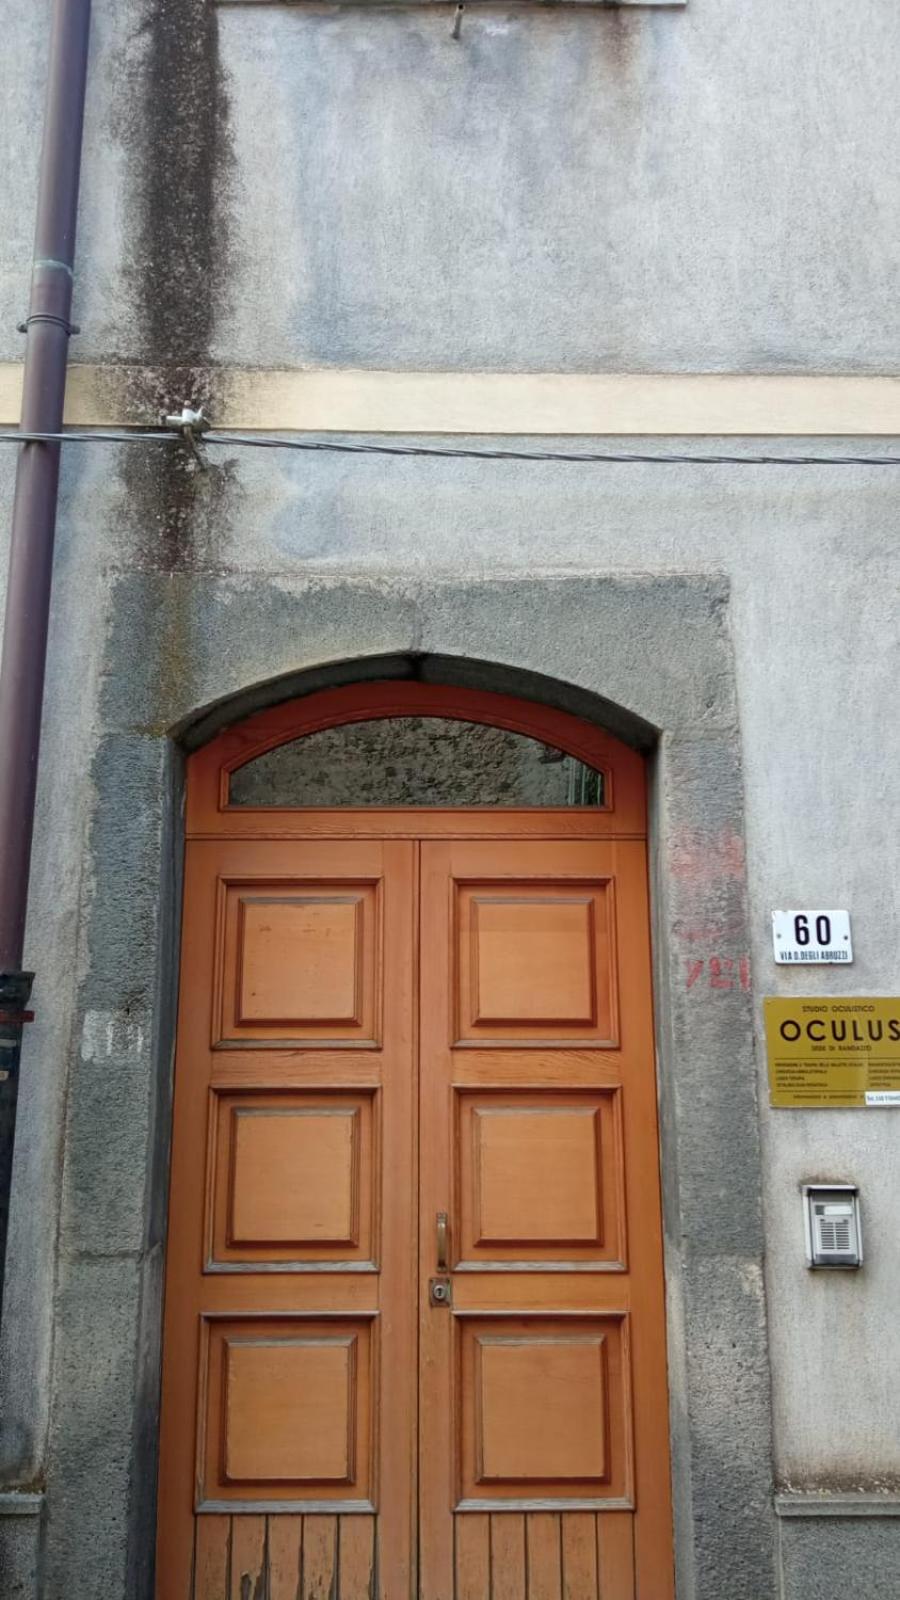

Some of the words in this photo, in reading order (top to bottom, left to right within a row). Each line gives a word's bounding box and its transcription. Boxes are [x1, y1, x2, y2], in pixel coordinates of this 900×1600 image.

[794, 914, 831, 946] 60
[779, 951, 792, 960] VIA
[800, 951, 819, 960] DEGLI
[821, 951, 848, 960] ABRUZZI
[780, 1019, 900, 1042] OCULUS
